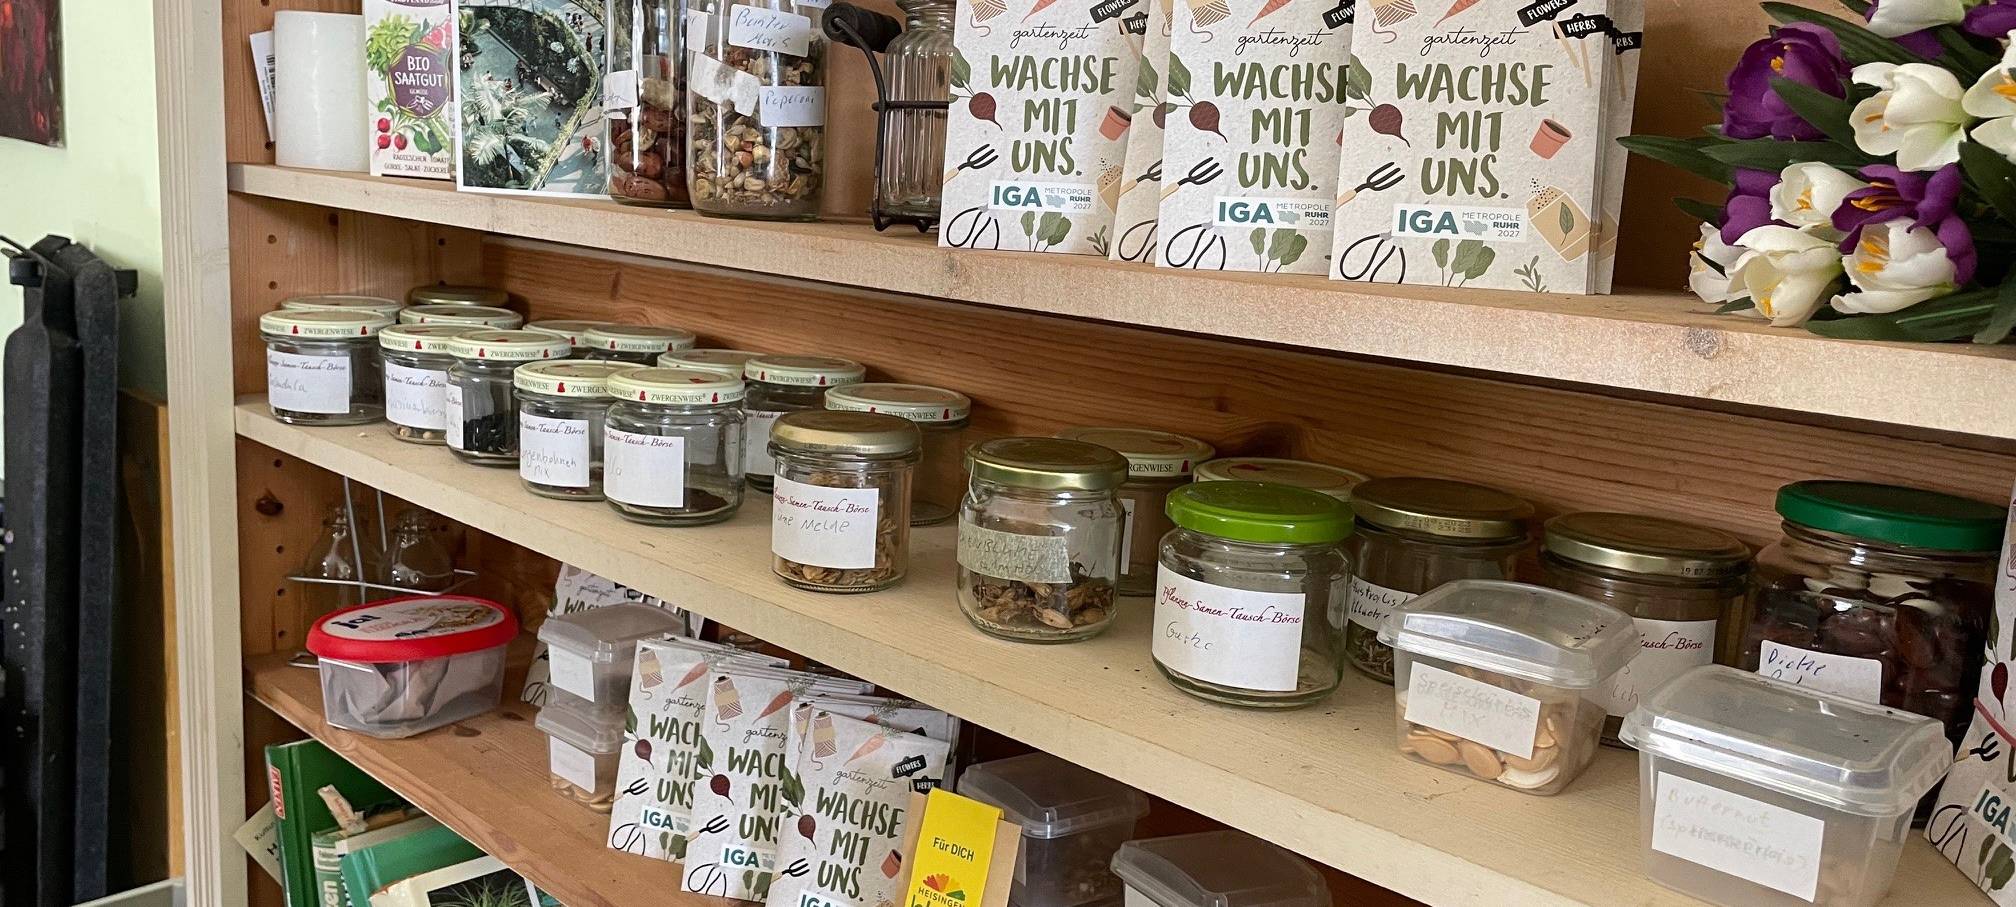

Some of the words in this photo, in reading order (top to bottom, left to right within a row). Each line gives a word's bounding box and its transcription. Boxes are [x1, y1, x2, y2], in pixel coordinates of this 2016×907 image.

[1526, 0, 1568, 20] FLOWERS
[1010, 21, 1099, 50] gartenzeit
[1566, 19, 1597, 34] HERBS
[1234, 27, 1333, 58] gartenzeit
[1420, 26, 1529, 58] gartenzeit
[407, 55, 430, 71] BIO
[991, 54, 1119, 95] WACHSE
[394, 71, 444, 87] SAATGUT
[1396, 62, 1553, 107] WACHSE
[1024, 97, 1078, 136] MIT
[1251, 106, 1312, 148] MIT
[1436, 110, 1504, 154] MIT
[1011, 136, 1082, 176] UNS.
[1238, 147, 1318, 190] UNS.
[1420, 154, 1509, 199] UNS.
[993, 185, 1042, 208] IGA
[1044, 187, 1092, 196] METROPOLE
[1069, 195, 1091, 203] RUHR
[1073, 202, 1092, 210] 2027
[1218, 201, 1274, 224] IGA
[1276, 202, 1330, 212] METROPOLE
[1462, 211, 1520, 222] METROPOLE
[1309, 218, 1329, 226] 2027
[1398, 209, 1459, 235] IGA
[1492, 221, 1520, 230] RUHR
[1497, 229, 1520, 238] 2027
[832, 767, 895, 795] gartenzeit
[642, 809, 674, 830] IGA
[816, 786, 905, 839] WACHSE
[1974, 788, 2011, 835] IGA
[723, 847, 760, 868] IGA
[830, 828, 871, 866] MIT
[932, 837, 950, 852] Für
[951, 842, 975, 863] DICH
[817, 860, 864, 902] UNS.
